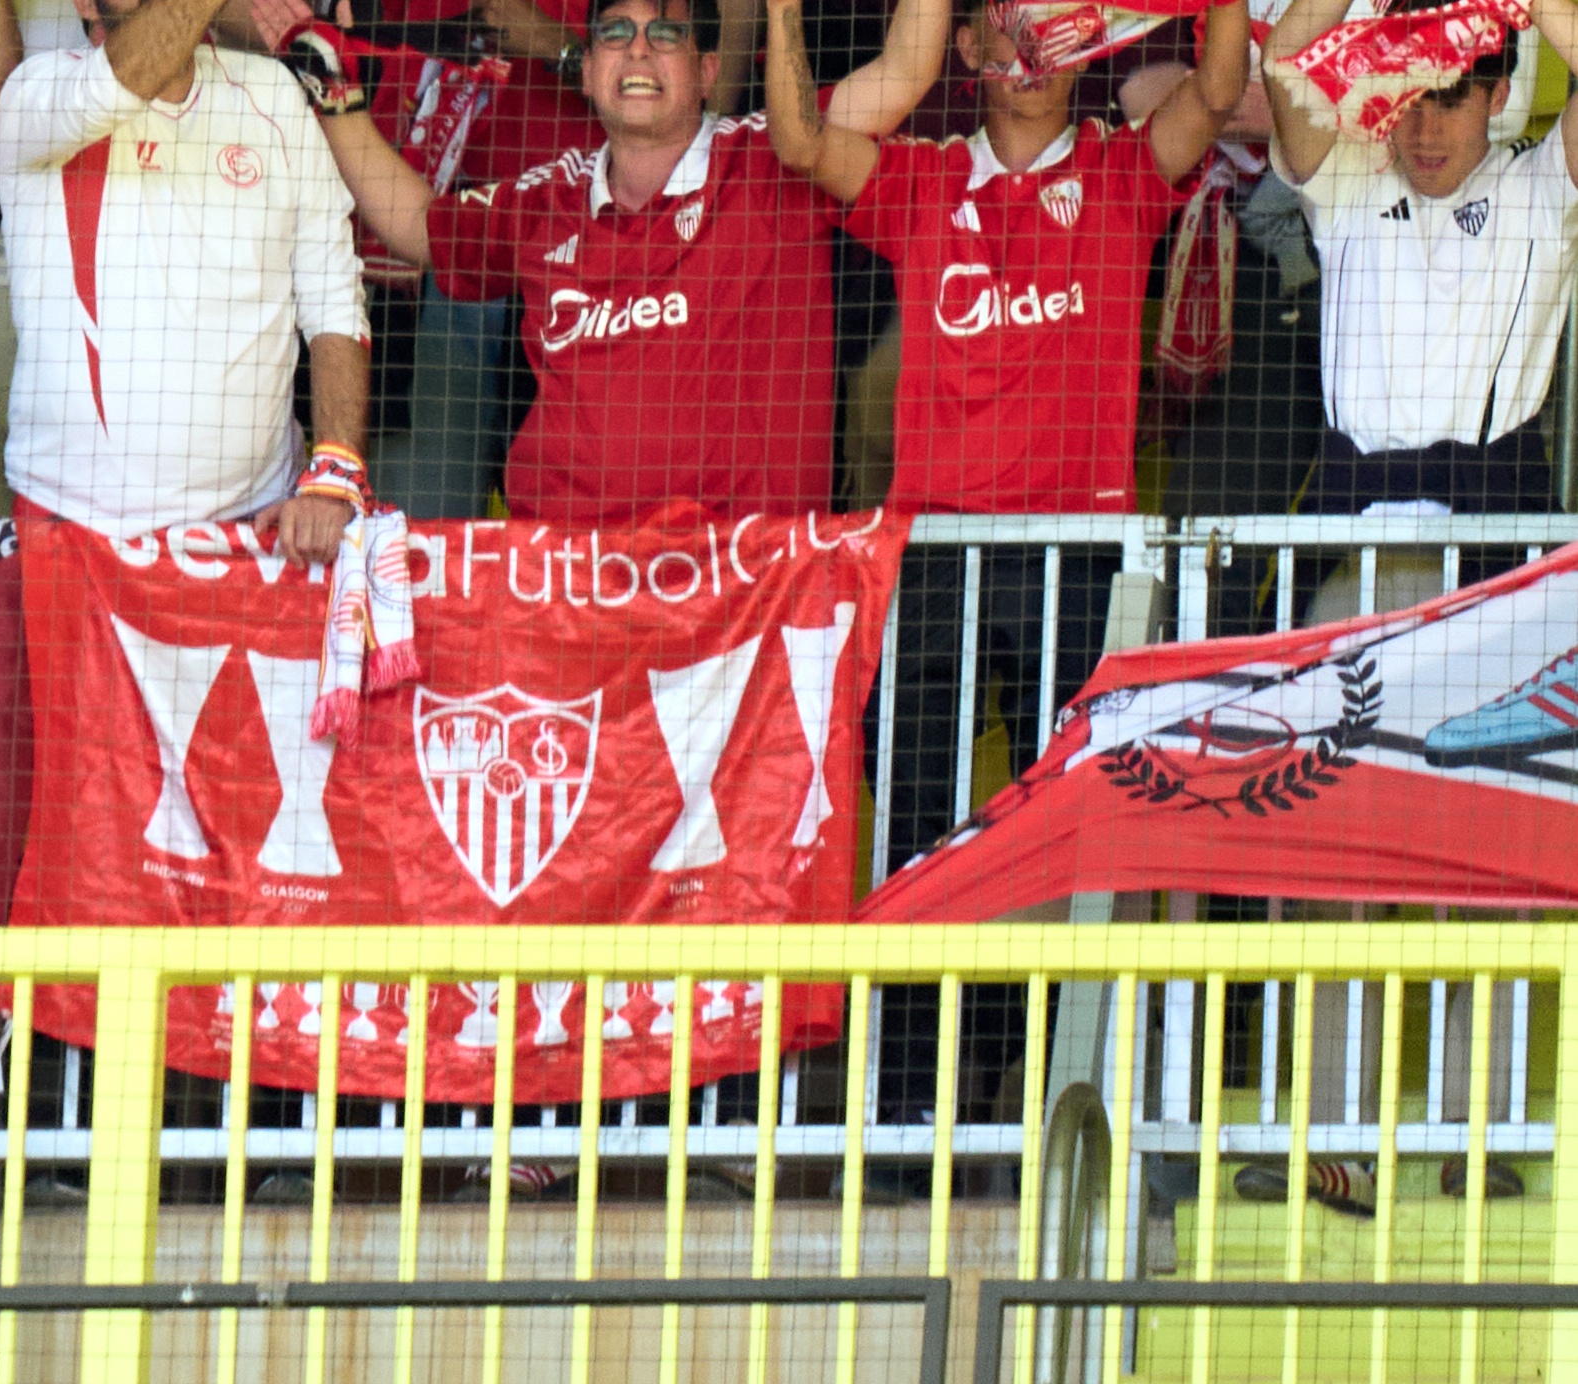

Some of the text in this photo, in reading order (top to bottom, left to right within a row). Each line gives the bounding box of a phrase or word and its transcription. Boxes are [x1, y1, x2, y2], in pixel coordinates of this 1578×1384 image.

[560, 291, 688, 344] Midea
[947, 276, 1083, 331] Midea
[108, 520, 447, 599] Seva
[260, 882, 330, 903] GLASGOW
